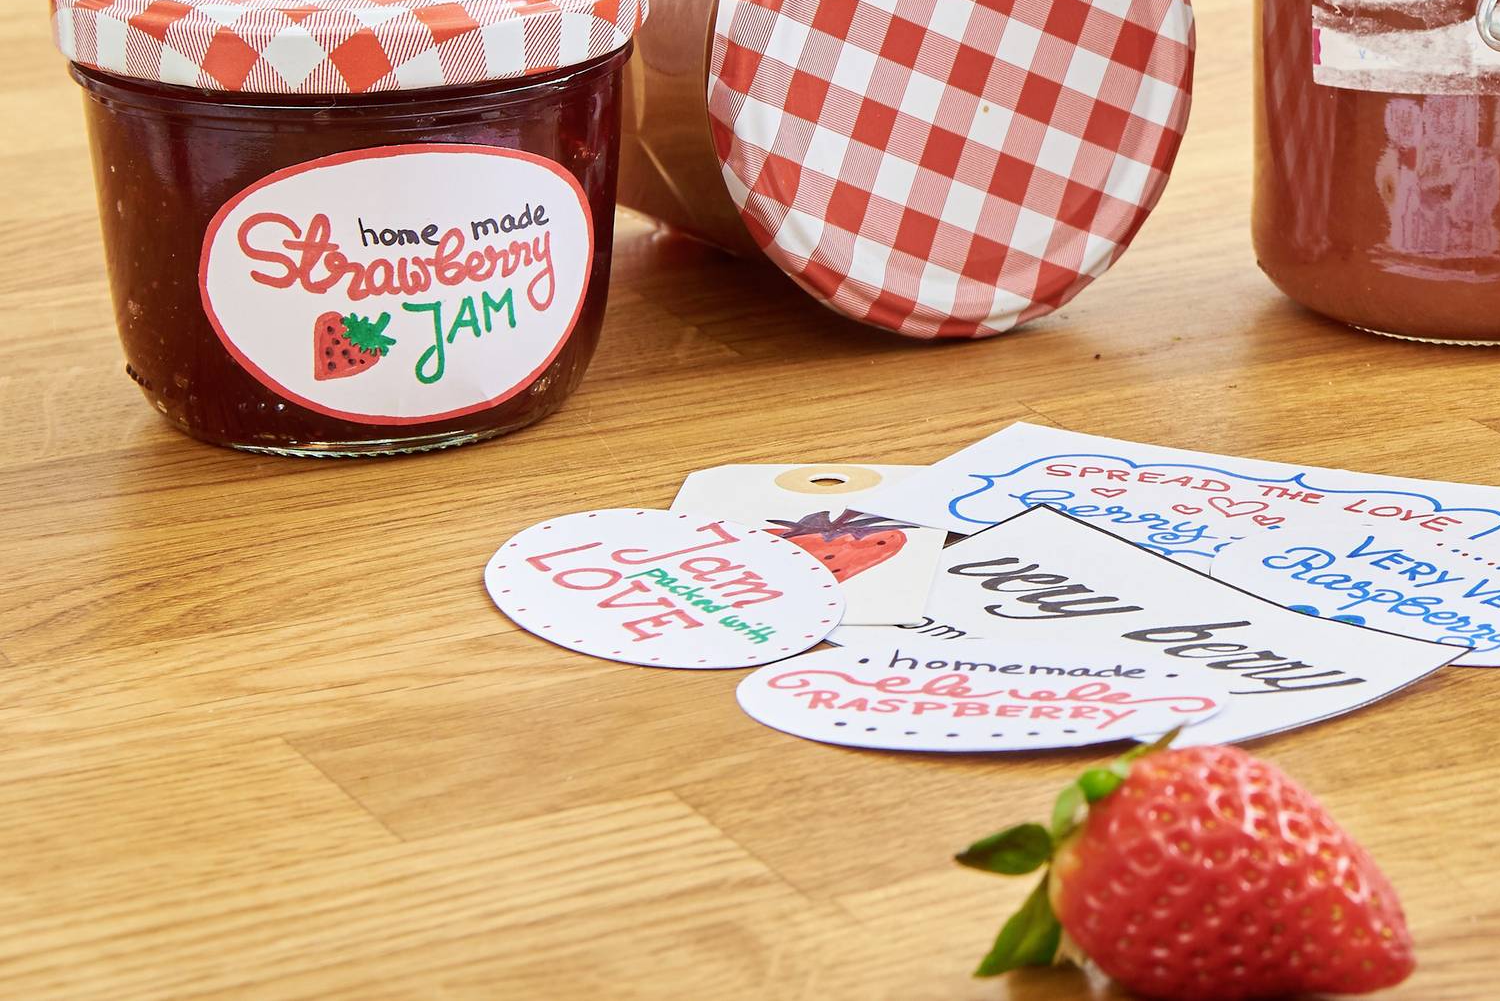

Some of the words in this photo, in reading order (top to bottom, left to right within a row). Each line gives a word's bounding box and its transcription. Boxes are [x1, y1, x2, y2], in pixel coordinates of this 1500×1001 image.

[358, 217, 440, 247] home
[470, 203, 550, 241] made
[238, 212, 555, 311] Strawberry
[403, 287, 516, 384] JAM
[1045, 464, 1231, 493] SPREAD
[1257, 482, 1325, 505] THE
[1343, 499, 1463, 532] LOVE
[525, 542, 704, 642] LOVE
[946, 557, 1144, 620] very
[1346, 535, 1465, 588] VERY
[623, 568, 732, 614] packed
[718, 614, 777, 645] with
[888, 649, 1147, 680] homemade
[1121, 620, 1367, 696] berry
[793, 688, 1139, 730] RASPBERRY
